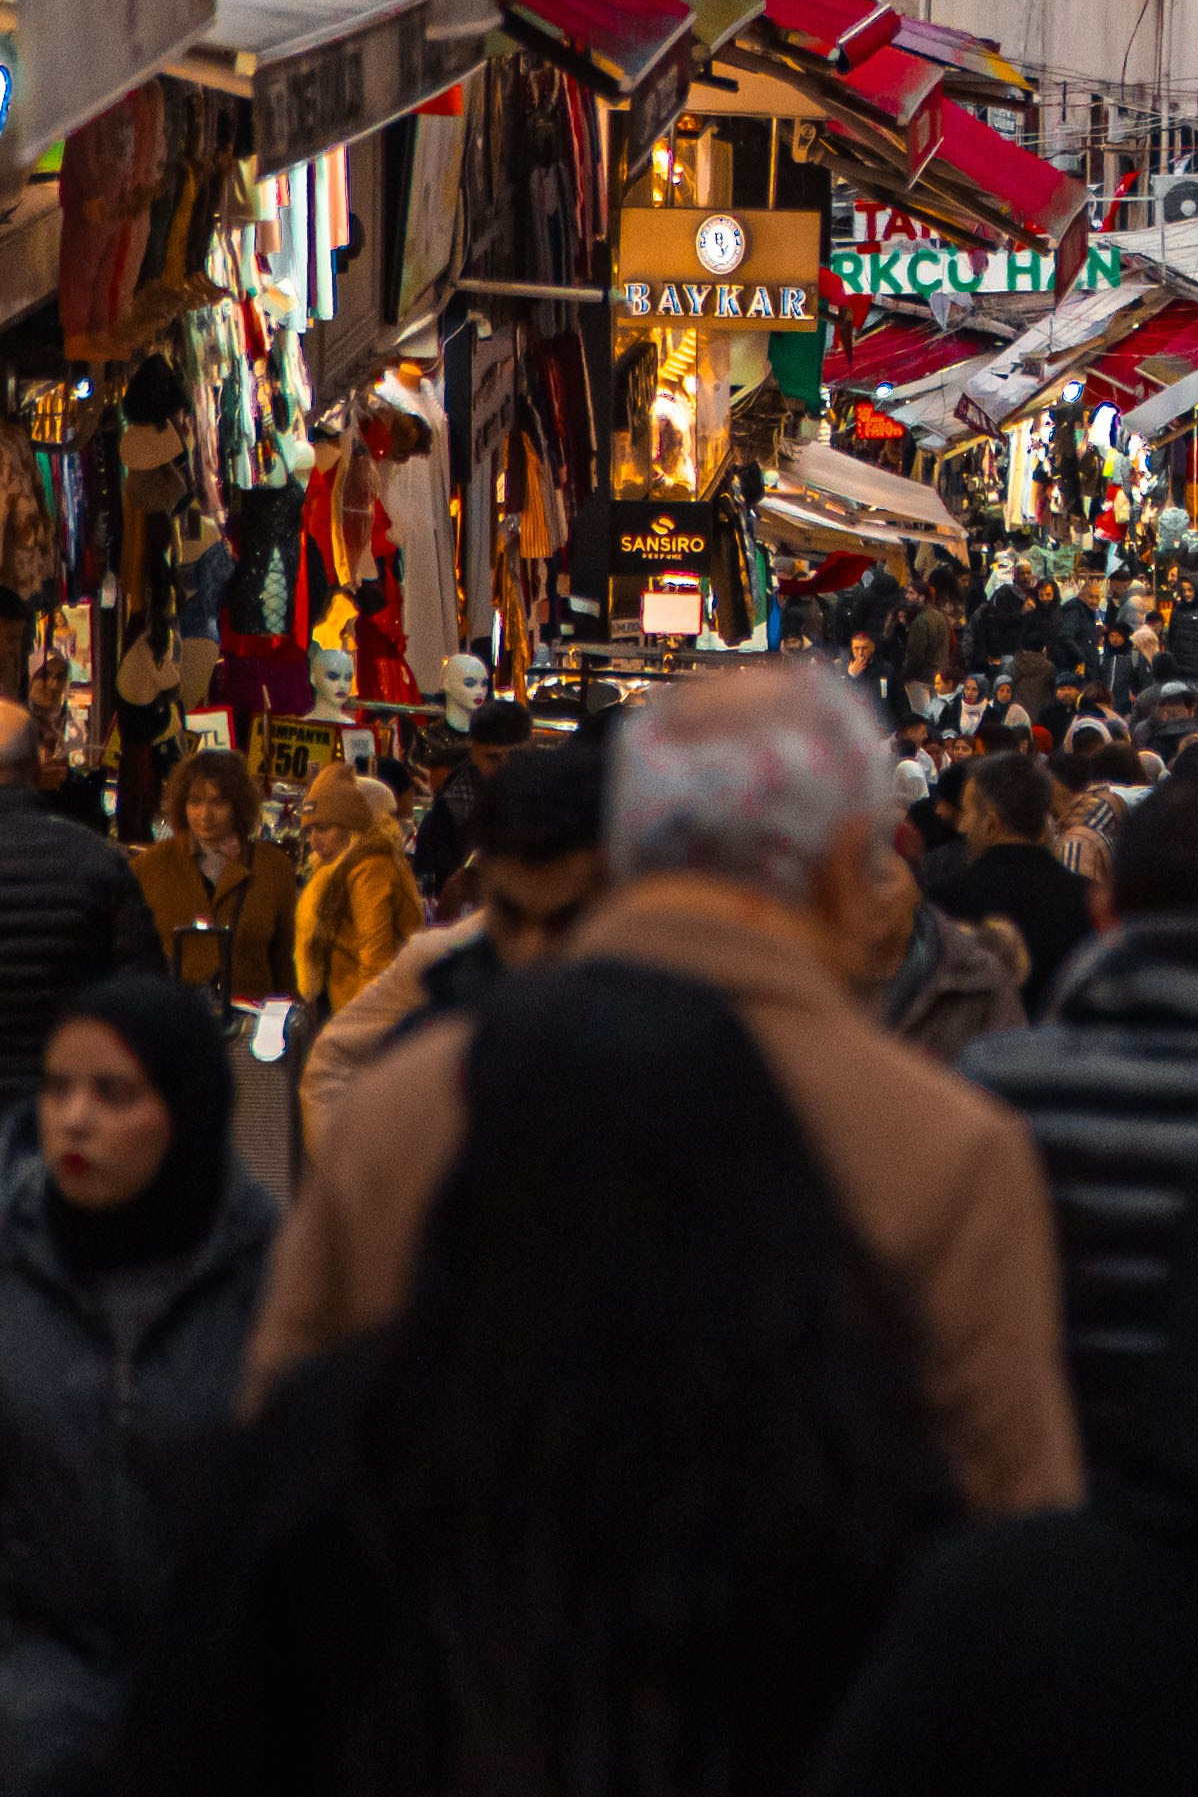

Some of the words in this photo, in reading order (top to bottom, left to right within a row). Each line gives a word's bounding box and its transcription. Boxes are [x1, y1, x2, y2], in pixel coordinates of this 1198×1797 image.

[855, 199, 931, 241] TA
[1007, 247, 1121, 292] HN
[624, 283, 815, 321] BAYKAR
